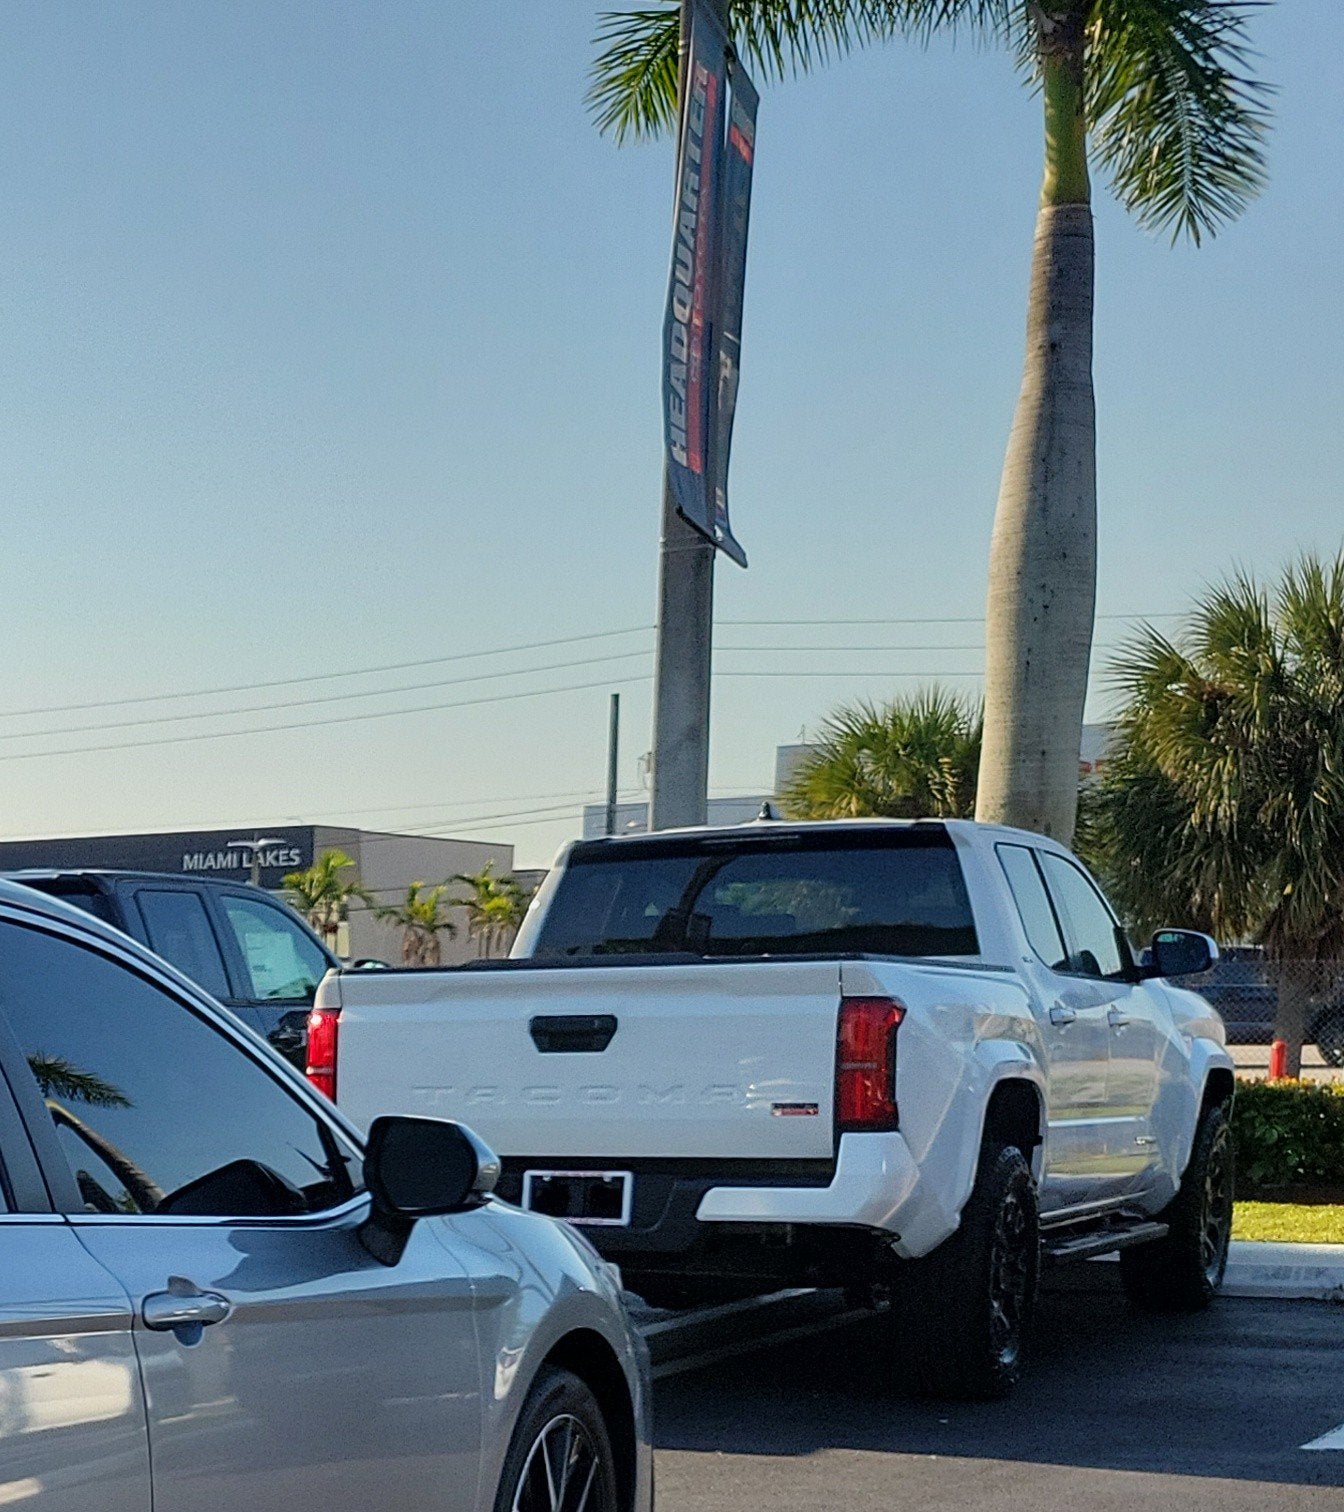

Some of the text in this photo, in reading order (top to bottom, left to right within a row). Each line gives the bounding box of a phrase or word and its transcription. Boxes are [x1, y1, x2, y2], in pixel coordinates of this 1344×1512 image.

[669, 60, 709, 468] HEADQUARTER
[183, 848, 300, 871] MIAMI LAKES
